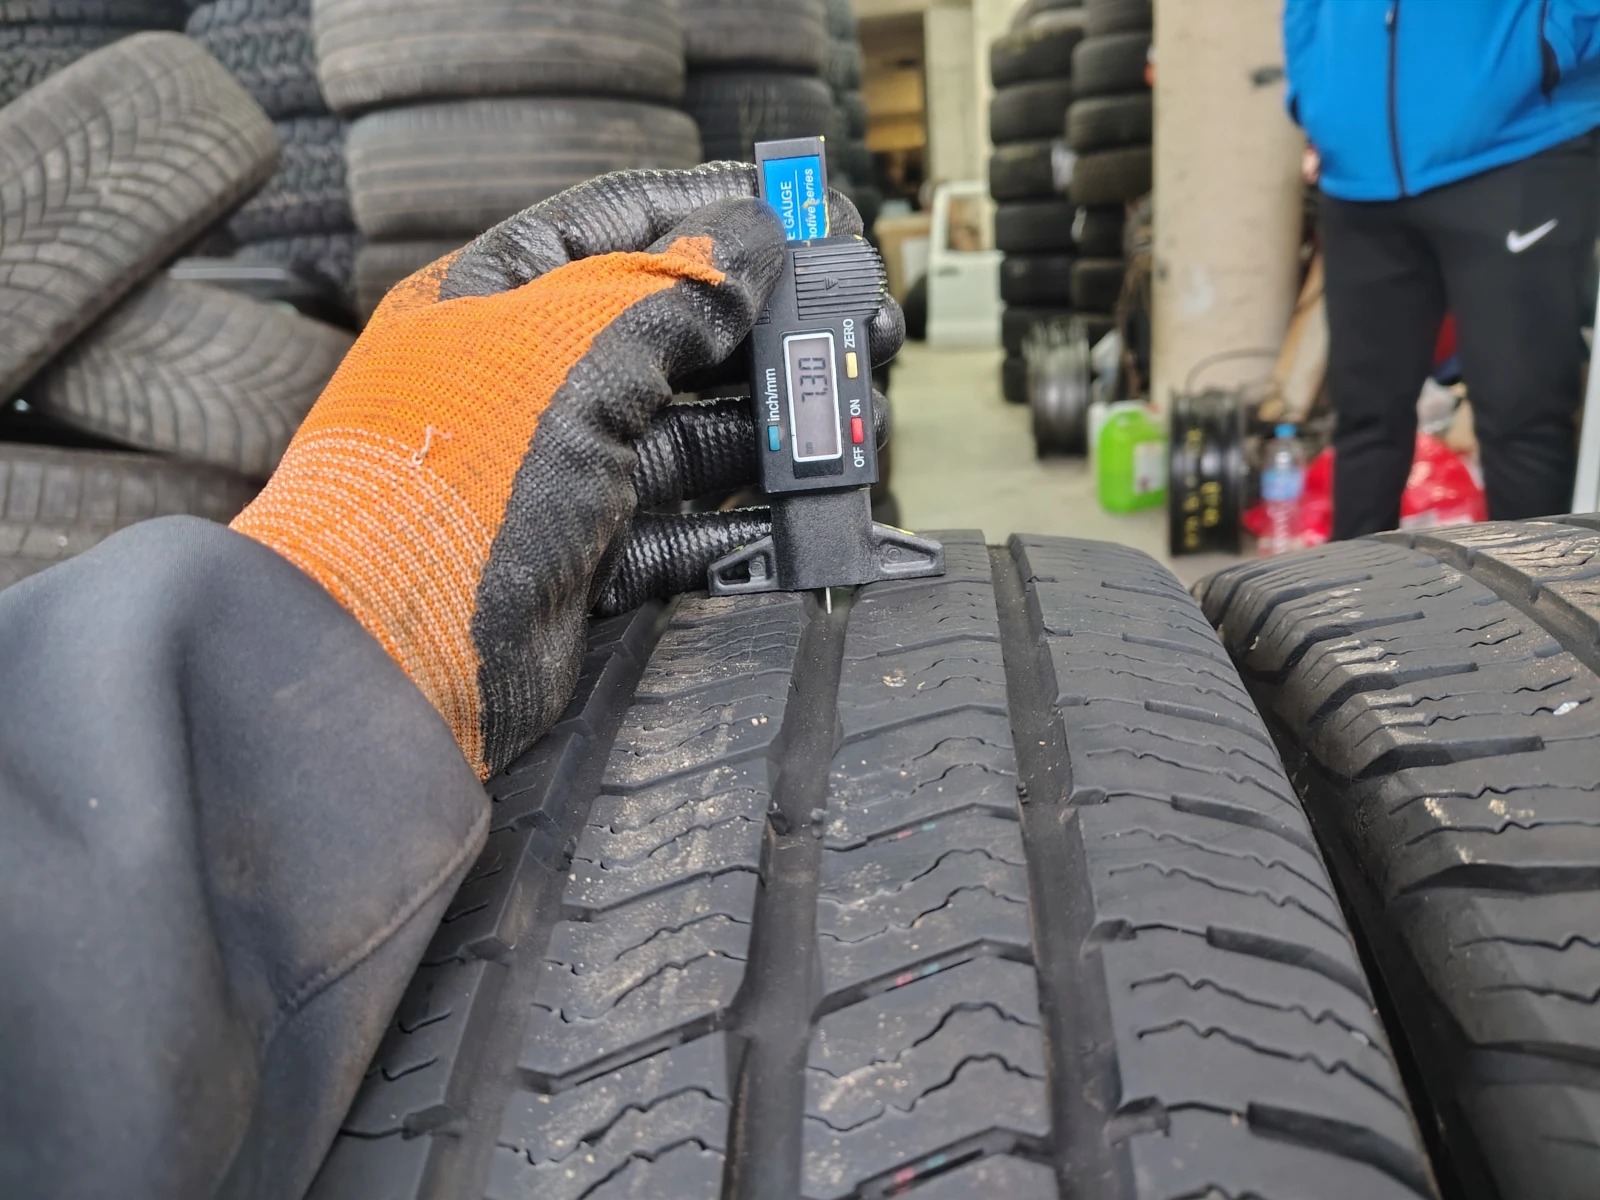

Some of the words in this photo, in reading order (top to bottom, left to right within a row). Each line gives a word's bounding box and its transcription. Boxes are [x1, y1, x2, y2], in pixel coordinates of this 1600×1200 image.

[803, 168, 815, 203] series
[780, 181, 795, 229] GAUGE
[843, 318, 856, 349] ZERO
[764, 367, 781, 422] inch/mm
[798, 357, 828, 403] 7.30
[849, 398, 861, 416] ON
[853, 446, 865, 468] OFF
